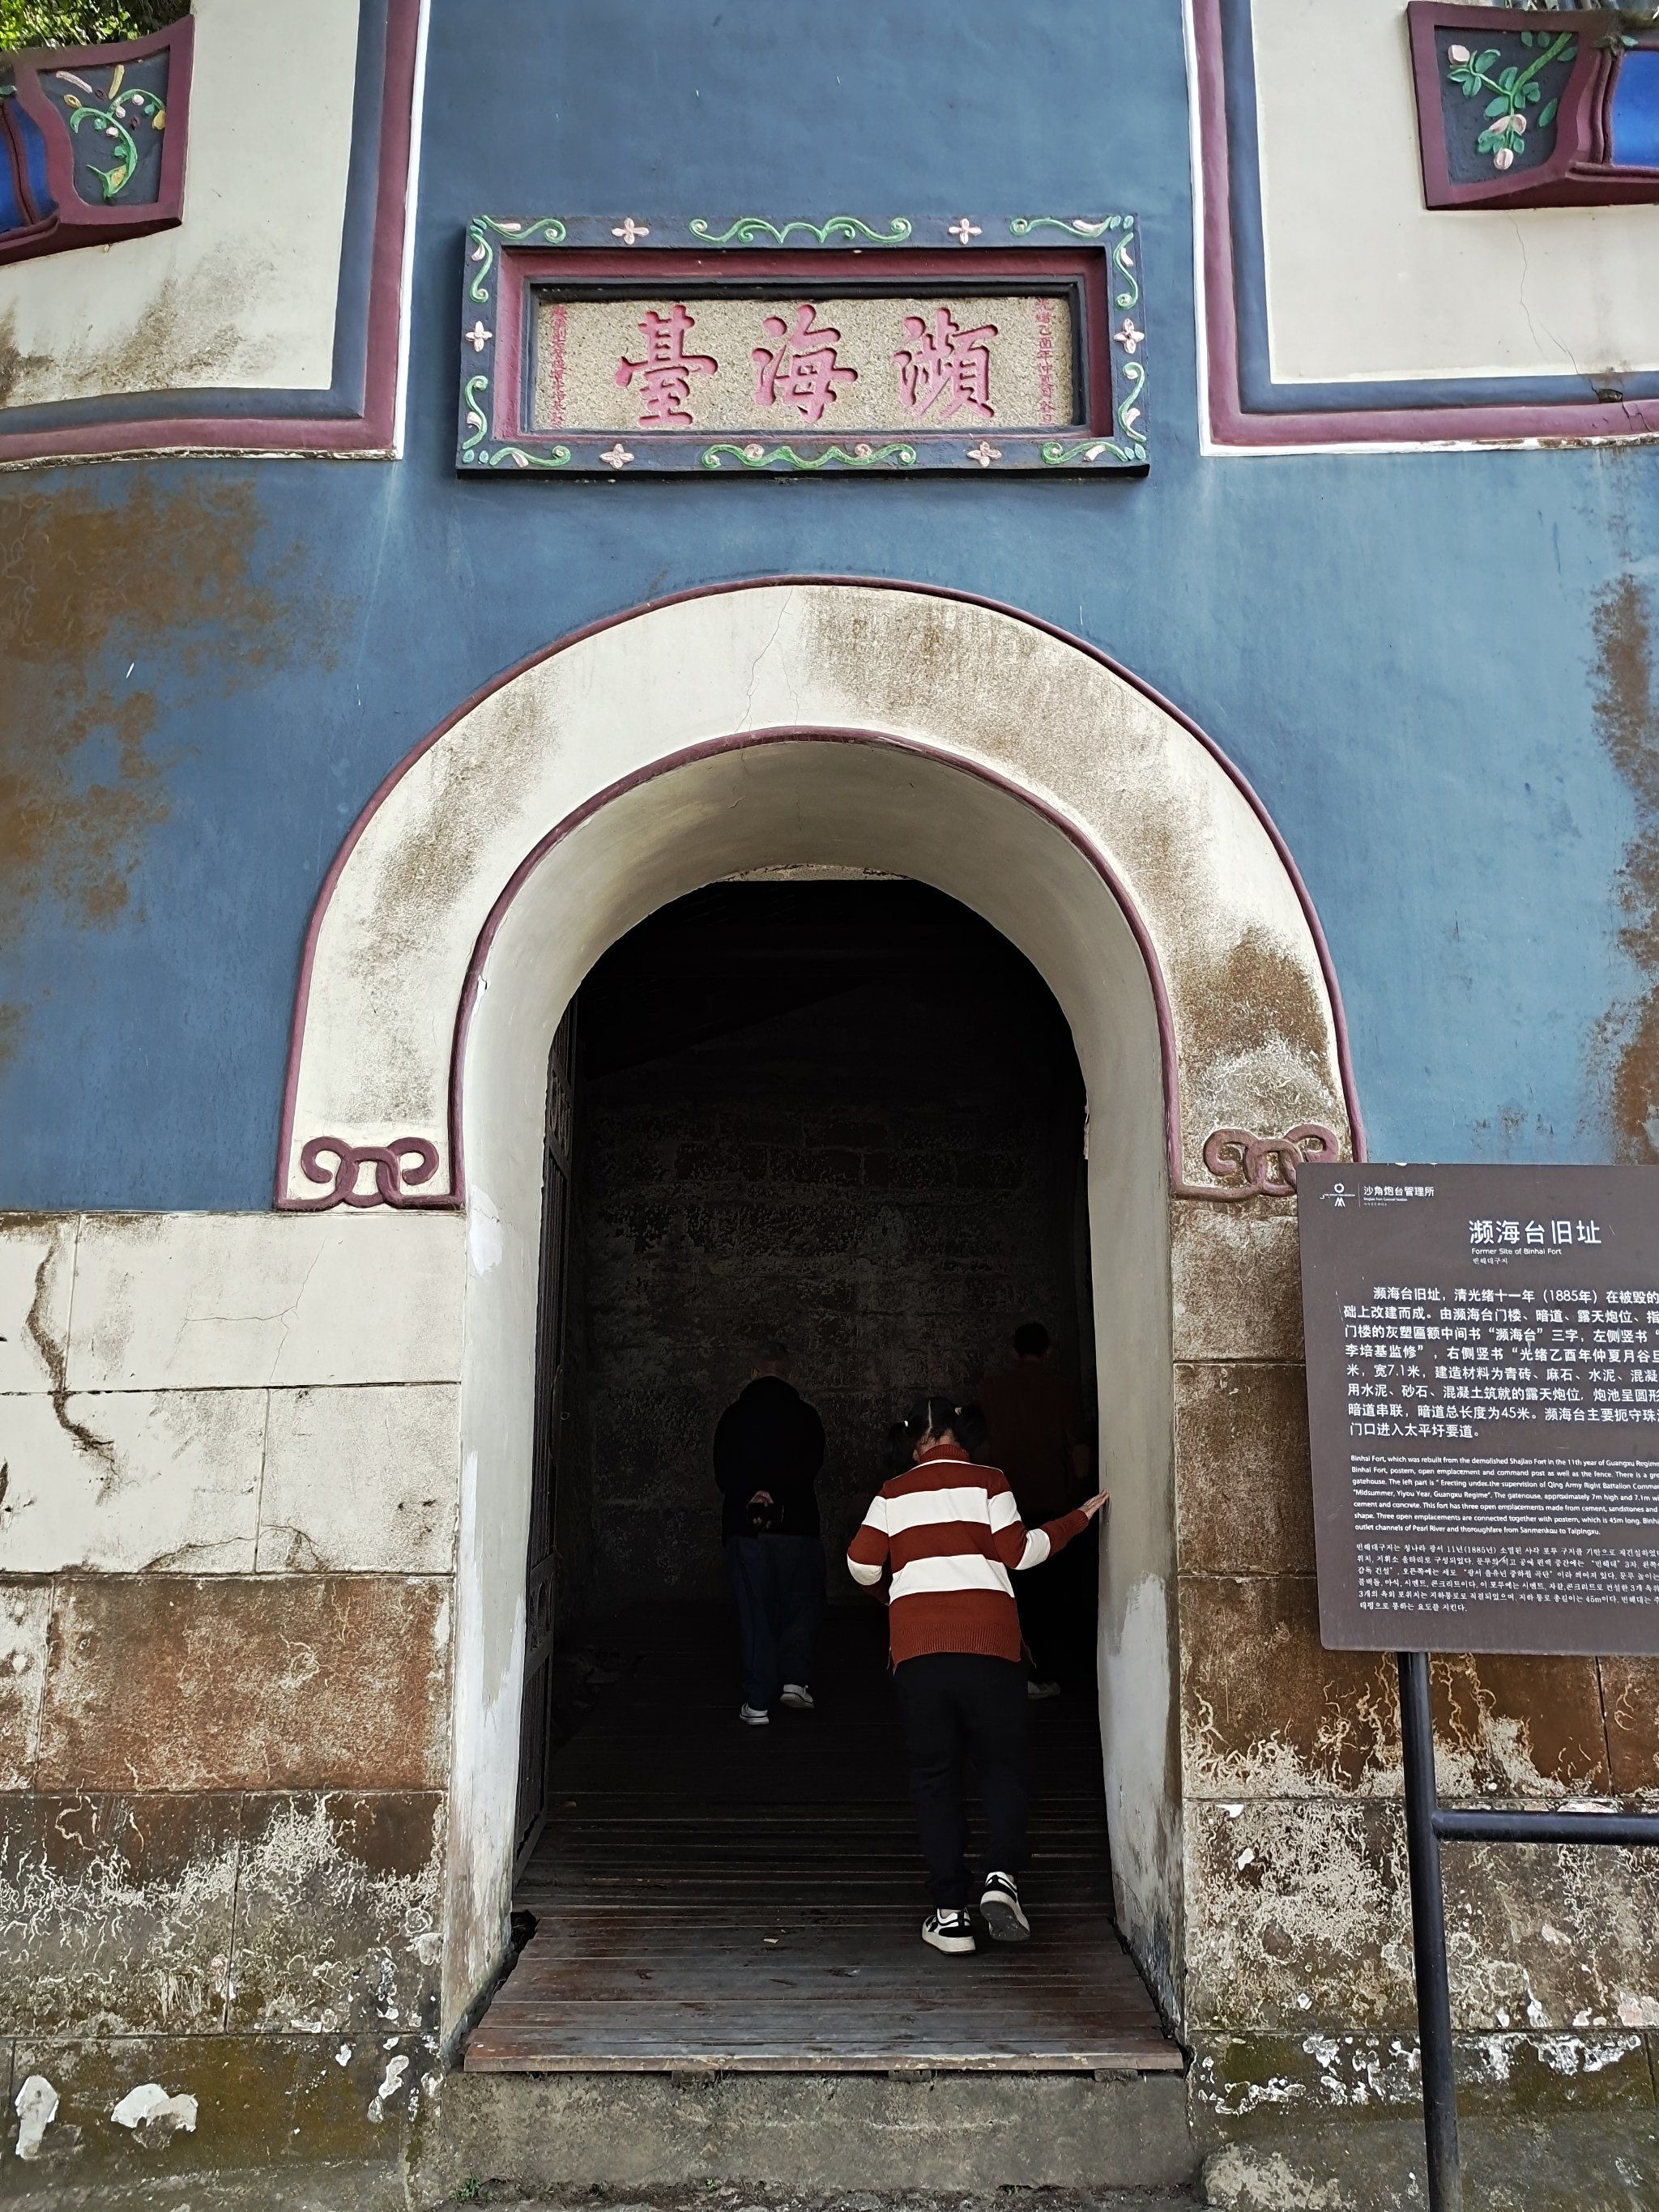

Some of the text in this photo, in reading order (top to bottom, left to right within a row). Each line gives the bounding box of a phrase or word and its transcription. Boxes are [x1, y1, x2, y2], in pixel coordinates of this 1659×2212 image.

[1363, 1185, 1435, 1199] 沙角炮台管理所
[1469, 1218, 1602, 1245] 濒海台旧址
